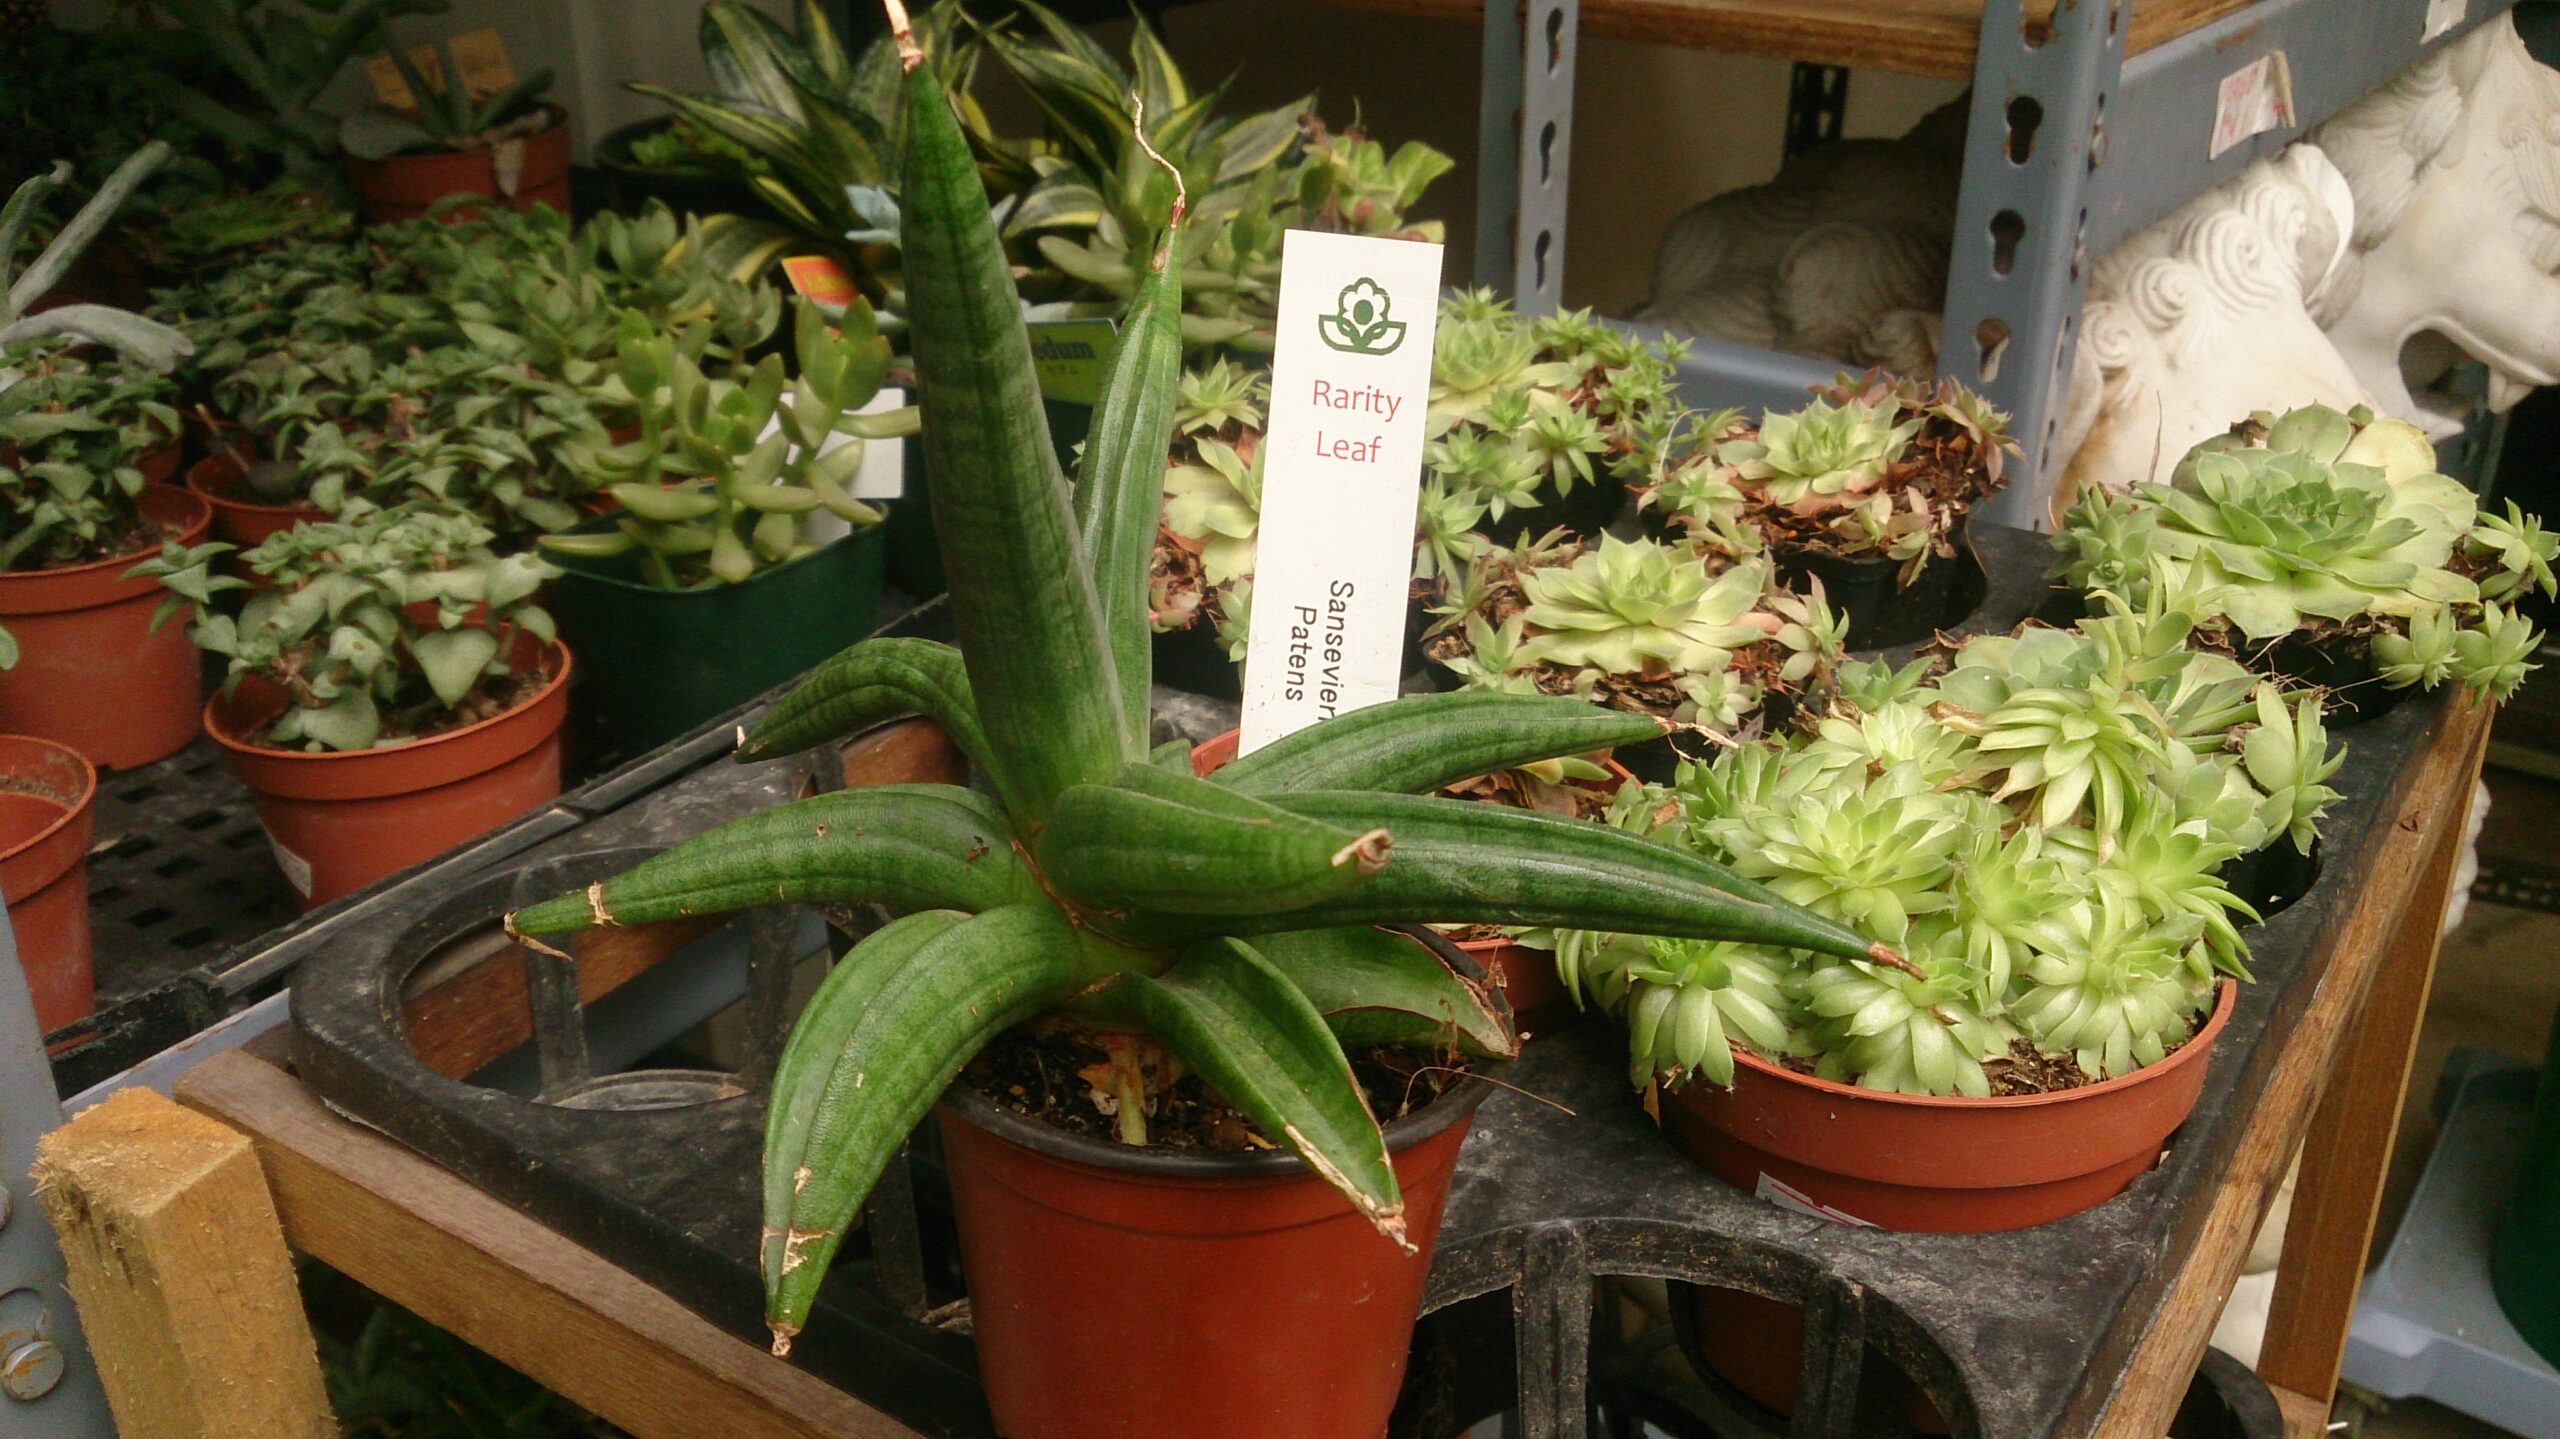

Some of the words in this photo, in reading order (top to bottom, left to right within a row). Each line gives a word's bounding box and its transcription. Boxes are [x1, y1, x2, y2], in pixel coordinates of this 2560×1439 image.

[1312, 379, 1402, 423] Rarity
[1316, 430, 1382, 463] Leaf
[1285, 605, 1318, 702] Patens
